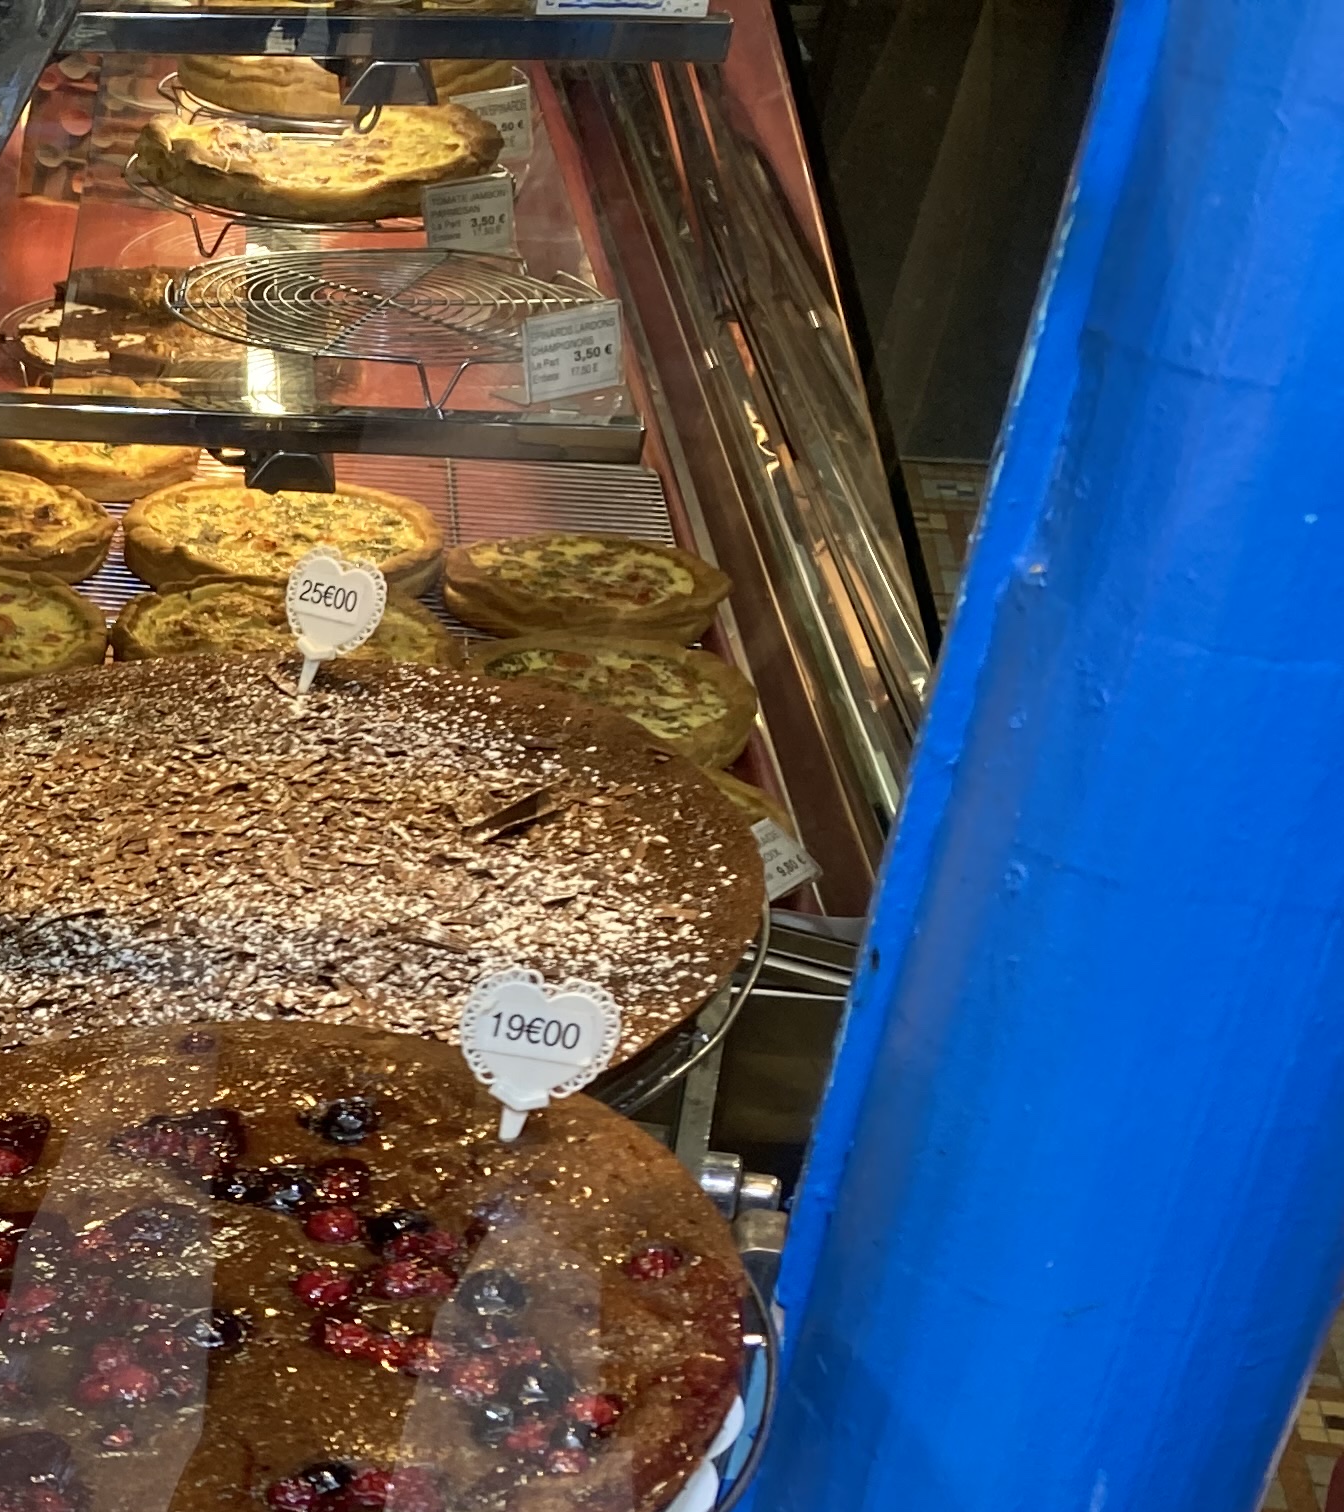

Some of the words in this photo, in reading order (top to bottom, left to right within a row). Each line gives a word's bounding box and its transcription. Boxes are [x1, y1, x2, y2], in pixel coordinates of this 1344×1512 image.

[470, 215, 495, 230] 3,50
[499, 213, 506, 225] €
[573, 346, 601, 362] 3,50
[604, 343, 613, 355] €
[298, 579, 358, 613] 25€00
[492, 1011, 581, 1050] 19€00
